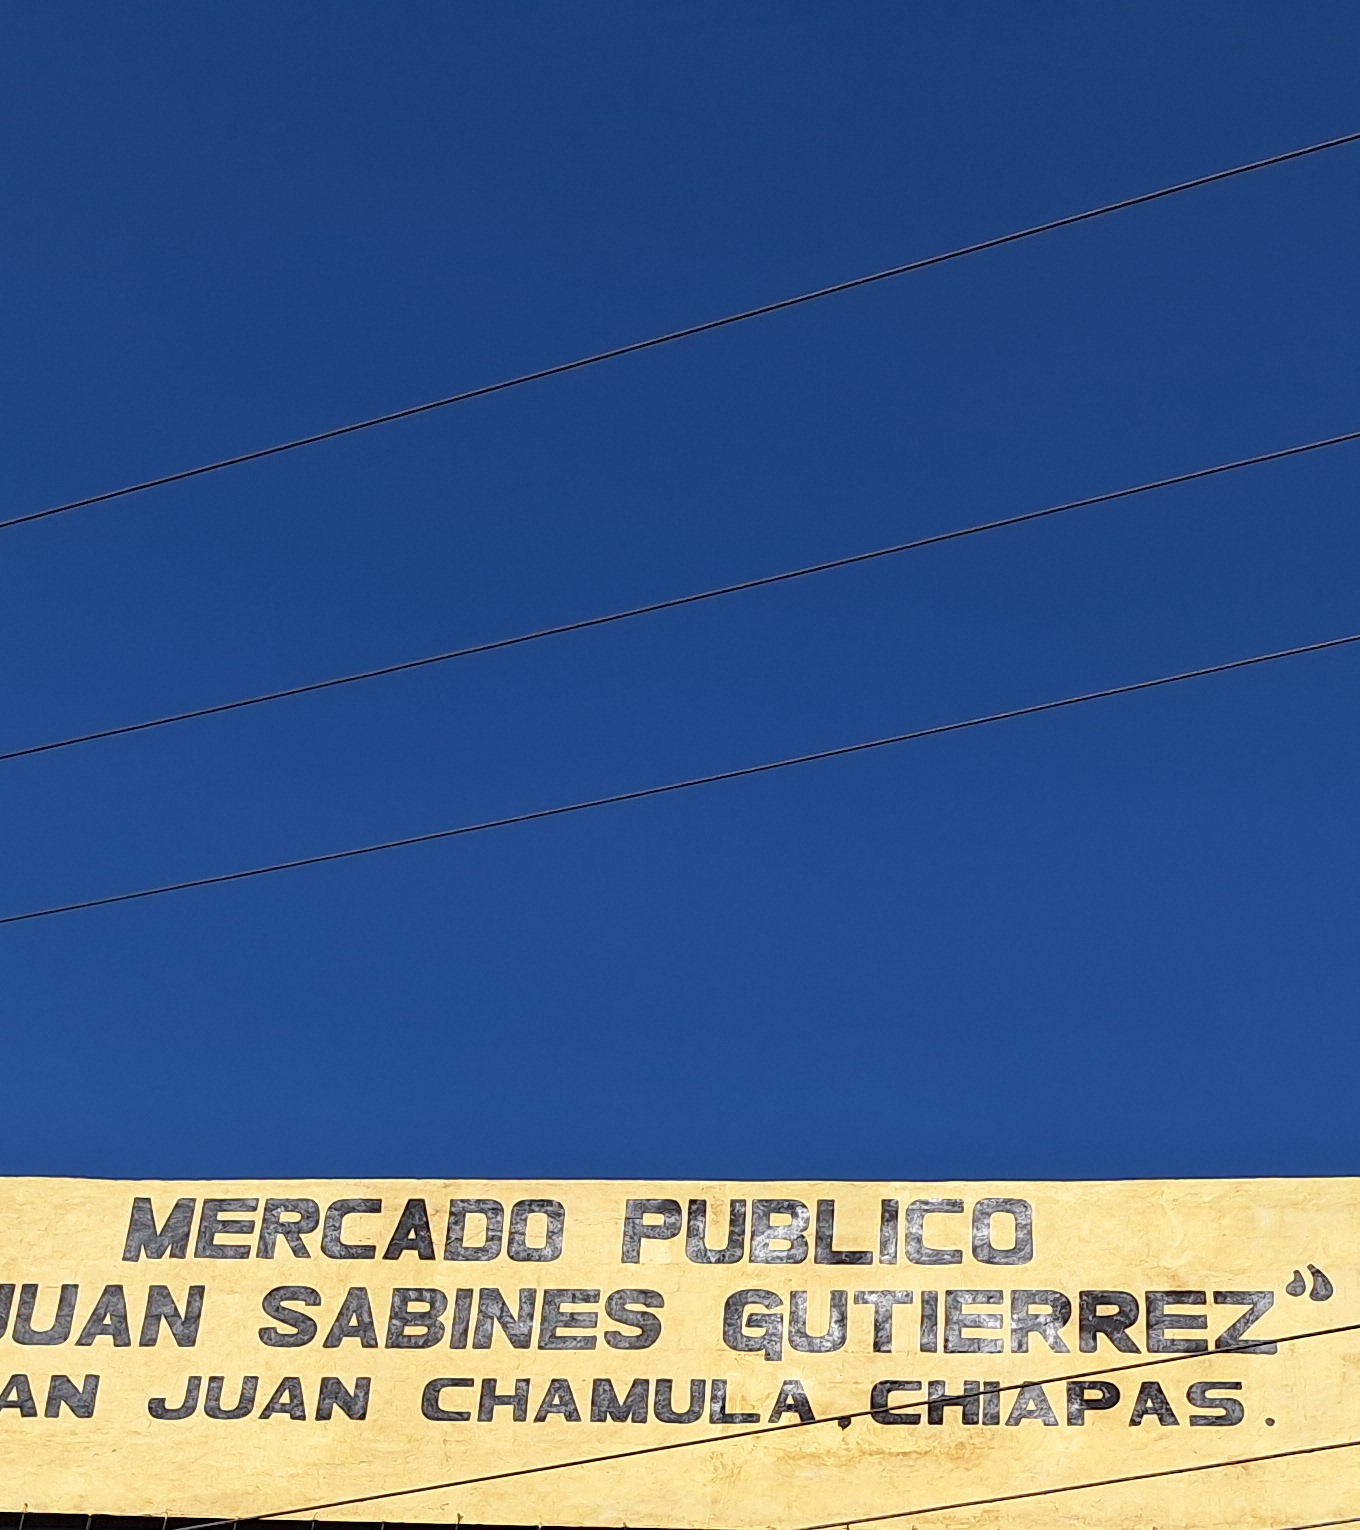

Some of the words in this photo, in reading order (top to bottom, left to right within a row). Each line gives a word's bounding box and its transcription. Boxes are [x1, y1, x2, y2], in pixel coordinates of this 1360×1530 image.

[122, 1197, 566, 1263] MERCADO
[621, 1197, 1034, 1266] PUBLICO
[258, 1285, 665, 1351] SABINES
[147, 1376, 372, 1422] JUAN
